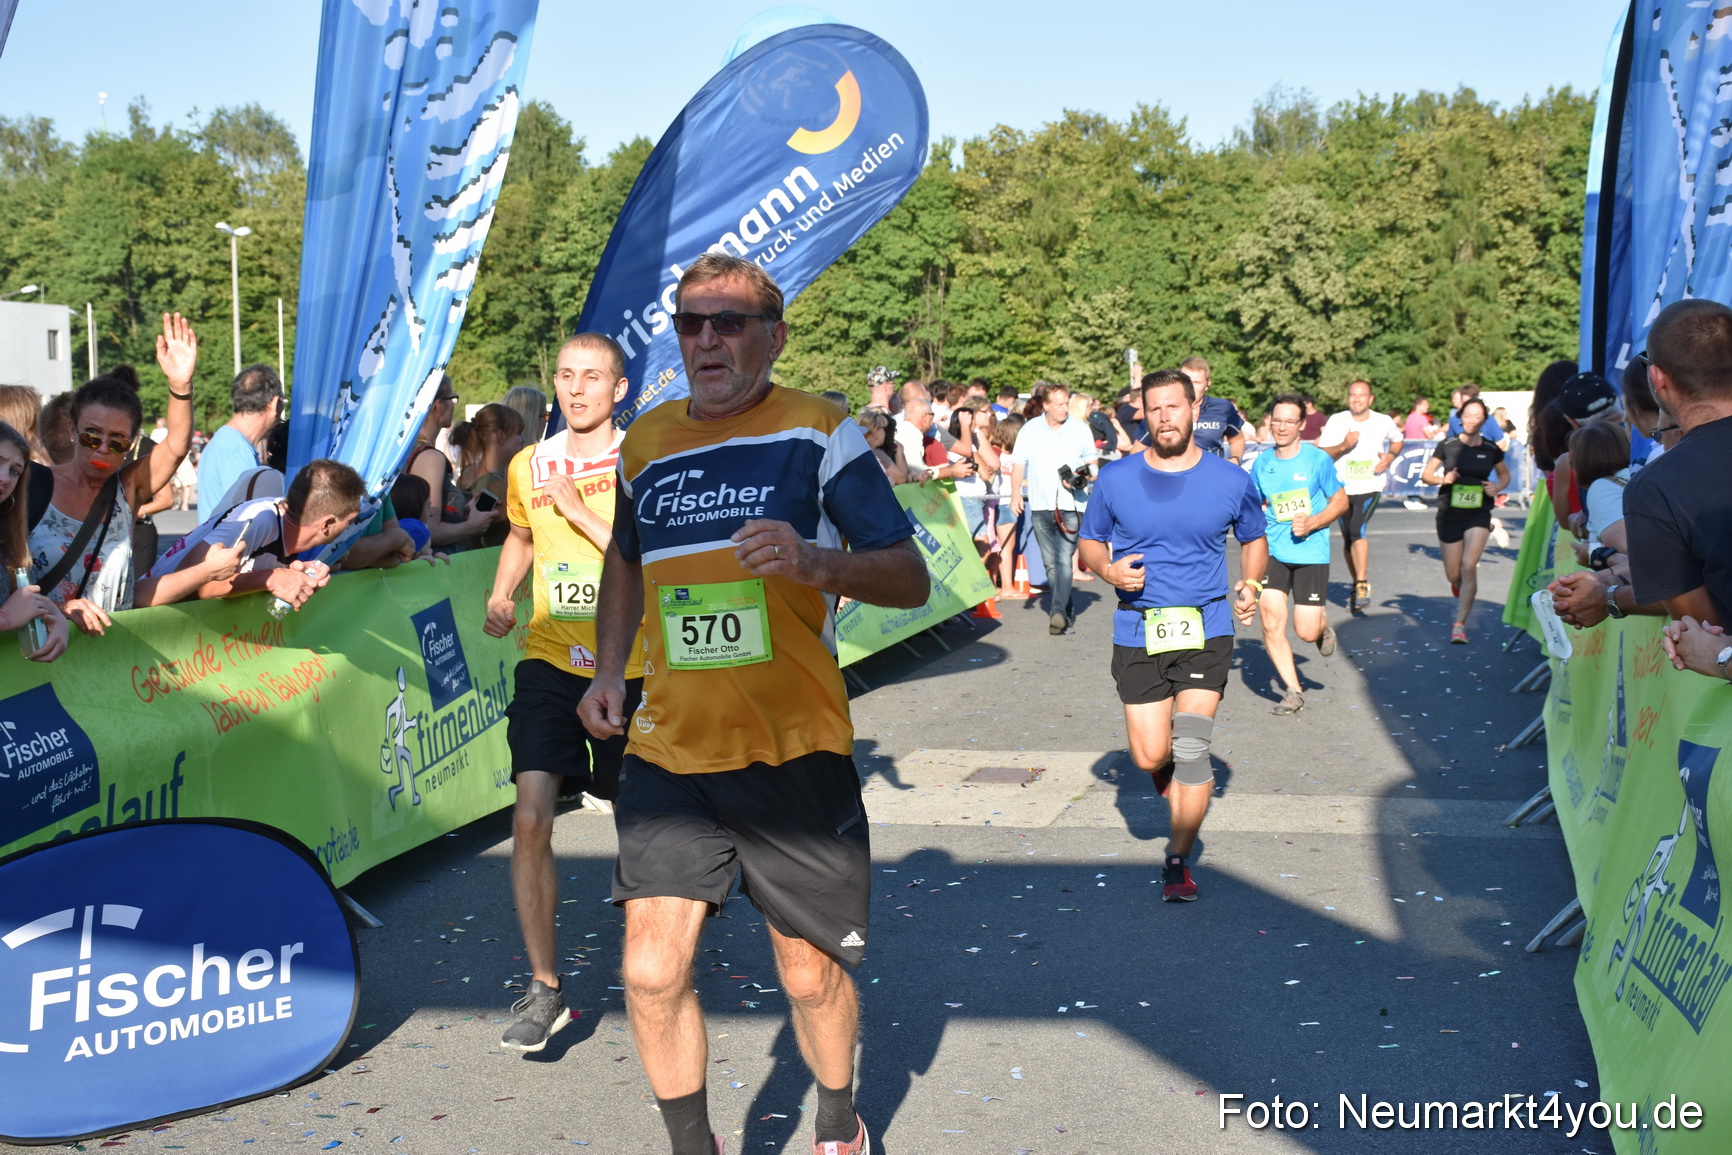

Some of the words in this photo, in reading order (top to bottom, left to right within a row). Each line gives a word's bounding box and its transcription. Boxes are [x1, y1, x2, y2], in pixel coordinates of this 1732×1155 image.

[753, 229, 797, 268] ruck
[795, 191, 834, 232] und
[832, 132, 905, 198] Medien
[605, 166, 820, 360] riscmann
[612, 367, 677, 428] nn-net.de
[1197, 421, 1220, 430] POLES
[655, 483, 775, 516] Fischer
[666, 506, 765, 527] AUTOMOBILE
[1277, 499, 1306, 514] 2134
[428, 632, 455, 659] Fischer
[682, 613, 742, 646] 570
[688, 647, 719, 655] Fischer
[720, 645, 740, 653] Otto
[1156, 620, 1191, 639] 672
[131, 632, 223, 703] Gesunde
[220, 621, 287, 667] Firmen
[200, 683, 277, 736] laufen
[257, 647, 337, 703] länger!
[417, 660, 509, 770] firmenlauf
[2, 727, 70, 769] Fischer
[17, 747, 75, 781] AUTOMOBILE
[48, 778, 63, 793] das
[425, 748, 470, 795] neumarkt
[29, 942, 305, 1032] Fischer
[1624, 981, 1664, 1033] neumarkt
[63, 995, 294, 1064] AUTOMOBILE
